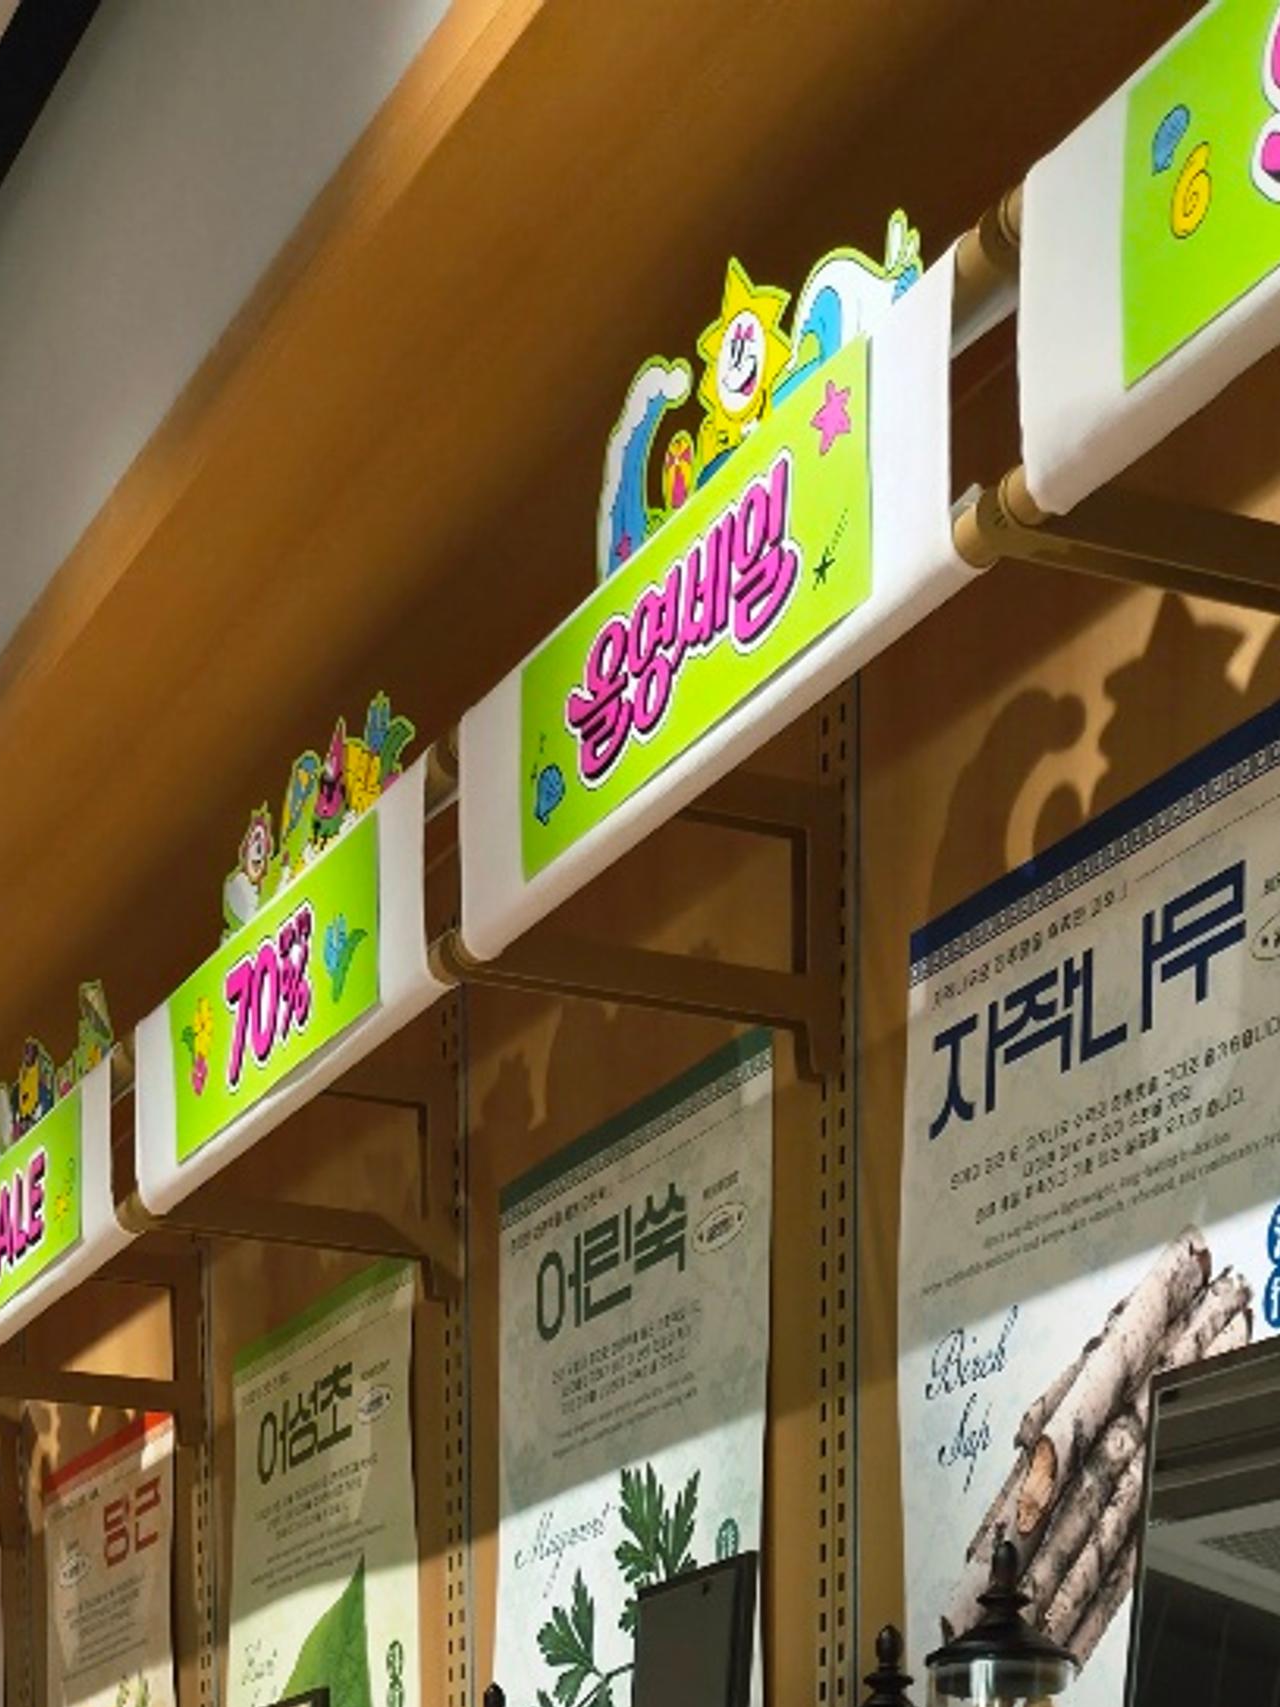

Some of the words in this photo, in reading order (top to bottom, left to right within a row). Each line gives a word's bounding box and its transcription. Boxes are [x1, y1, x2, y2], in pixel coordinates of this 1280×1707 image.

[568, 448, 803, 789] 올영세일
[224, 899, 314, 1092] 70%
[928, 860, 1247, 1140] 자작나무
[536, 1183, 687, 1342] 어린쑥
